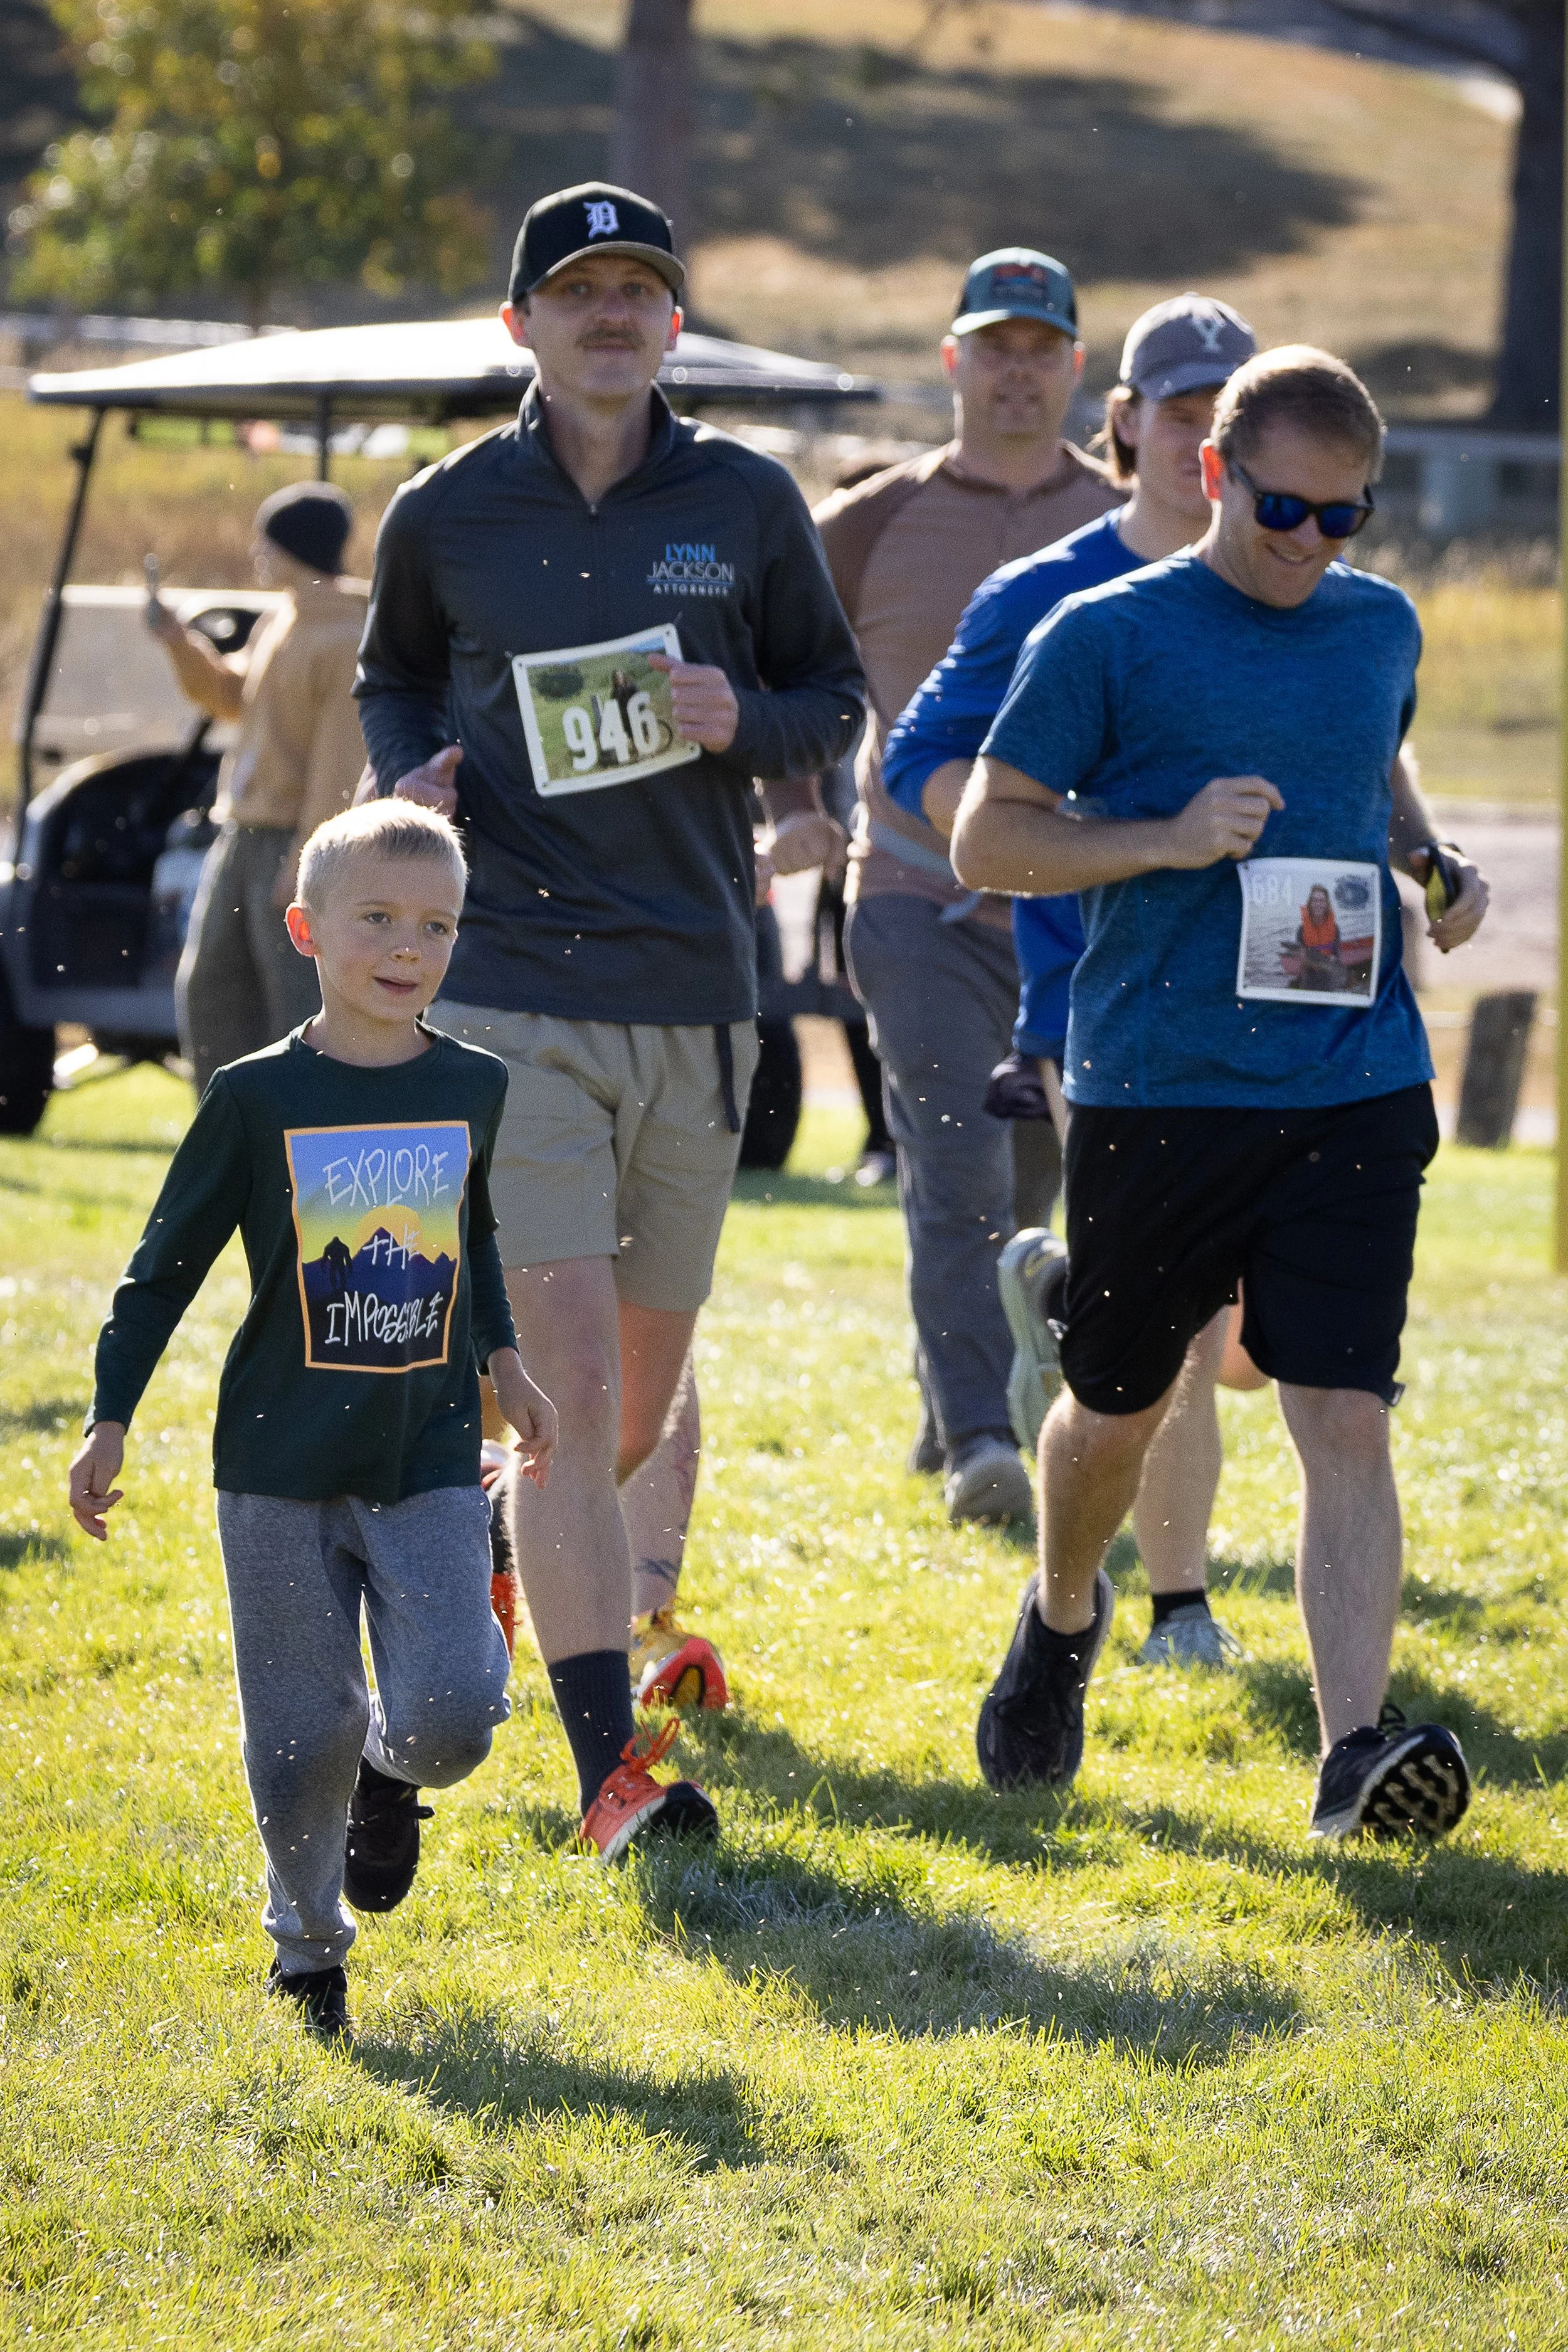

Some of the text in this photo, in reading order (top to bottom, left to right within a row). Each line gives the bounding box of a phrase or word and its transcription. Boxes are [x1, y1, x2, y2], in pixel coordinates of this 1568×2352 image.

[583, 200, 620, 240] D
[647, 561, 735, 583] JACKSON
[665, 543, 716, 563] LYNN
[562, 691, 661, 771] 946
[322, 1143, 450, 1210] EXPLORE
[362, 1224, 420, 1270] THE
[324, 1290, 444, 1347] IMPOSSIBLE
